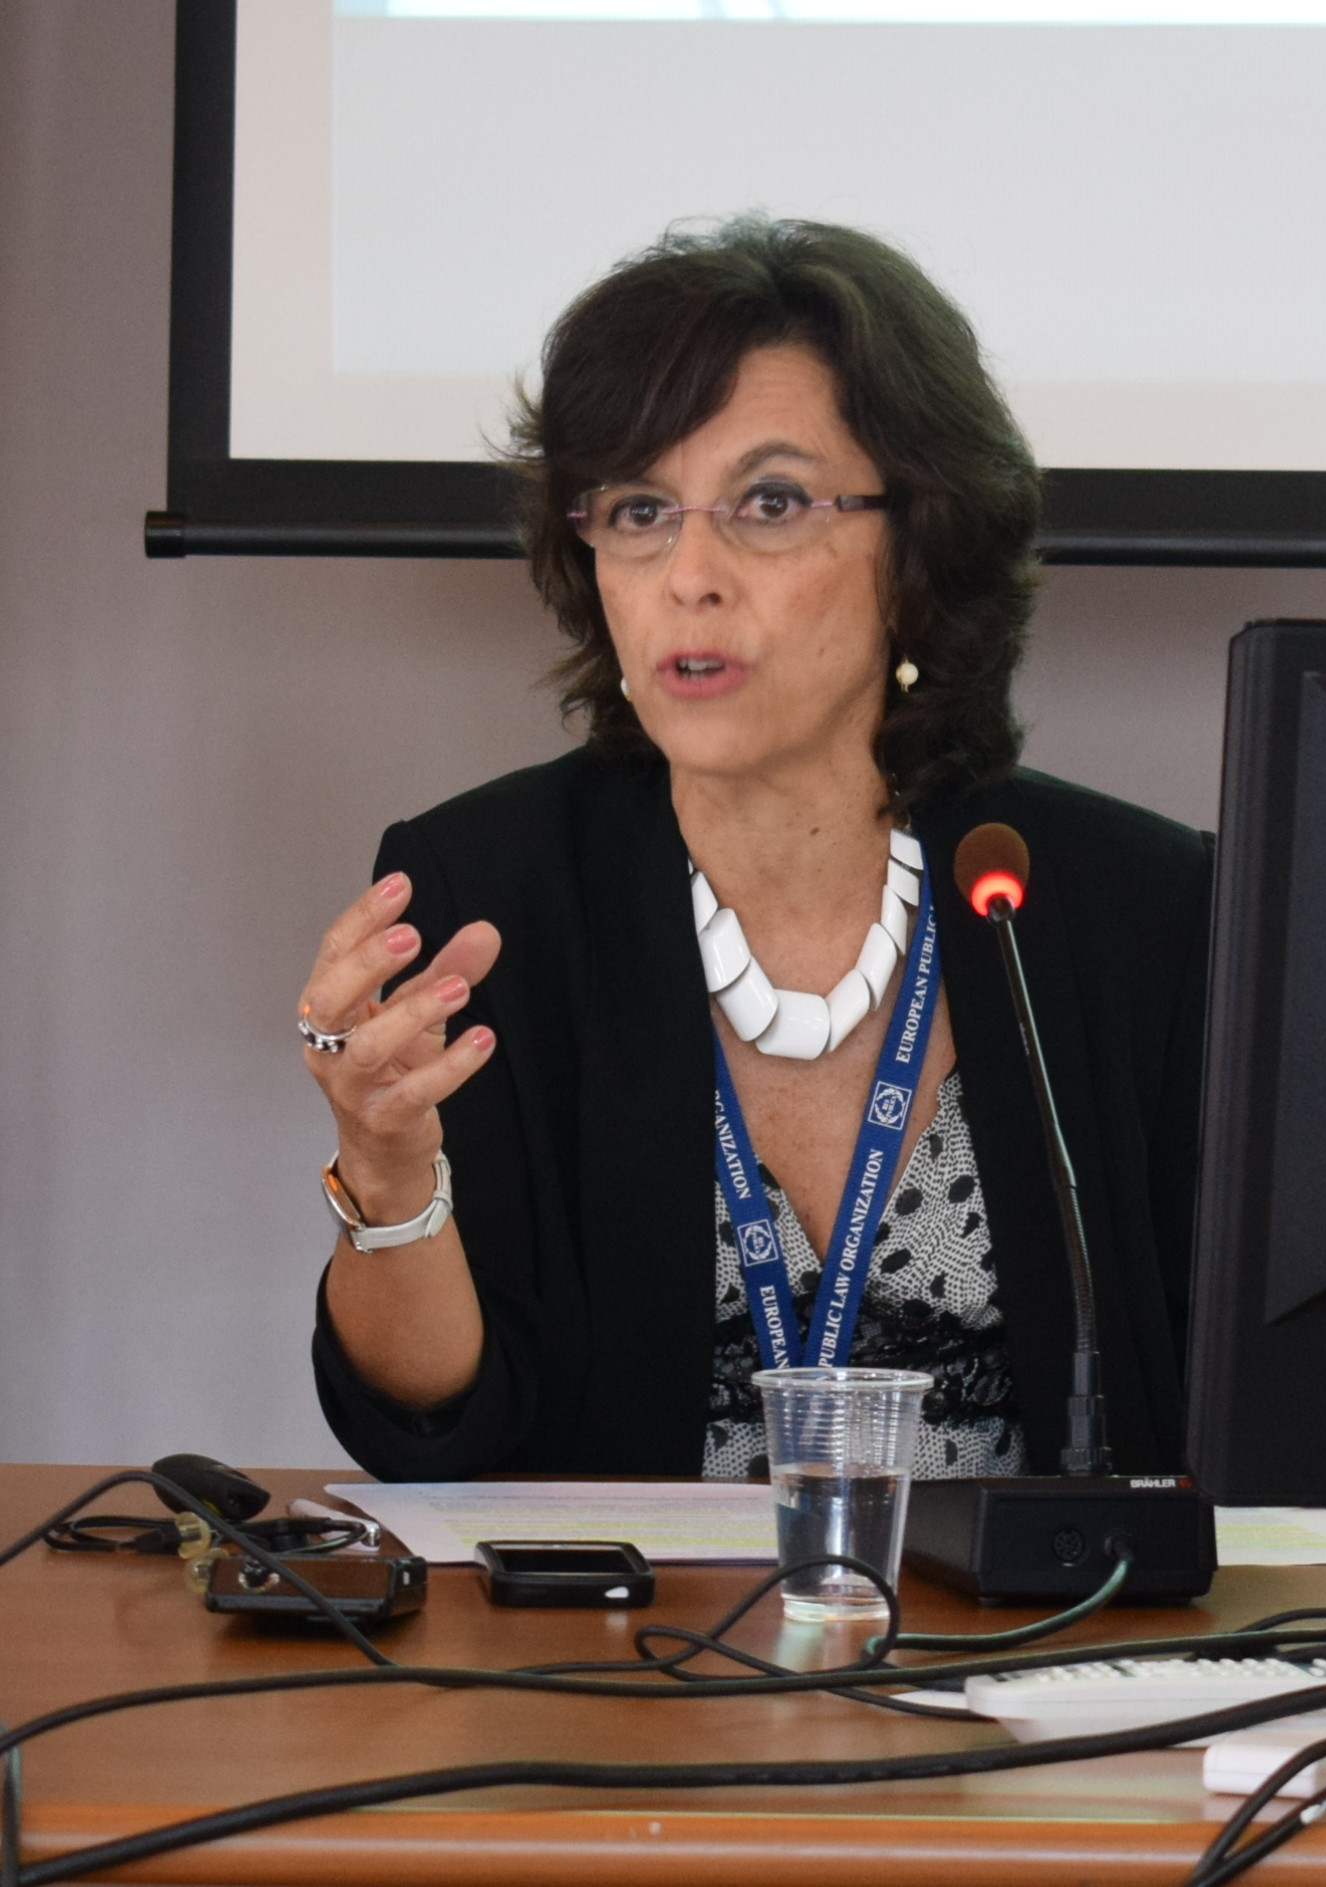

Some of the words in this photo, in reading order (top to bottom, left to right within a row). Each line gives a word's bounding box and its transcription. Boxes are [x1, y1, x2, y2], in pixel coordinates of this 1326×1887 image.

[896, 976, 928, 1064] EUROPEAN
[840, 1148, 883, 1271] ORGANIZATION
[760, 1285, 790, 1370] EUROPEAN
[830, 1272, 851, 1309] LAW
[818, 1310, 843, 1368] PUBLIC
